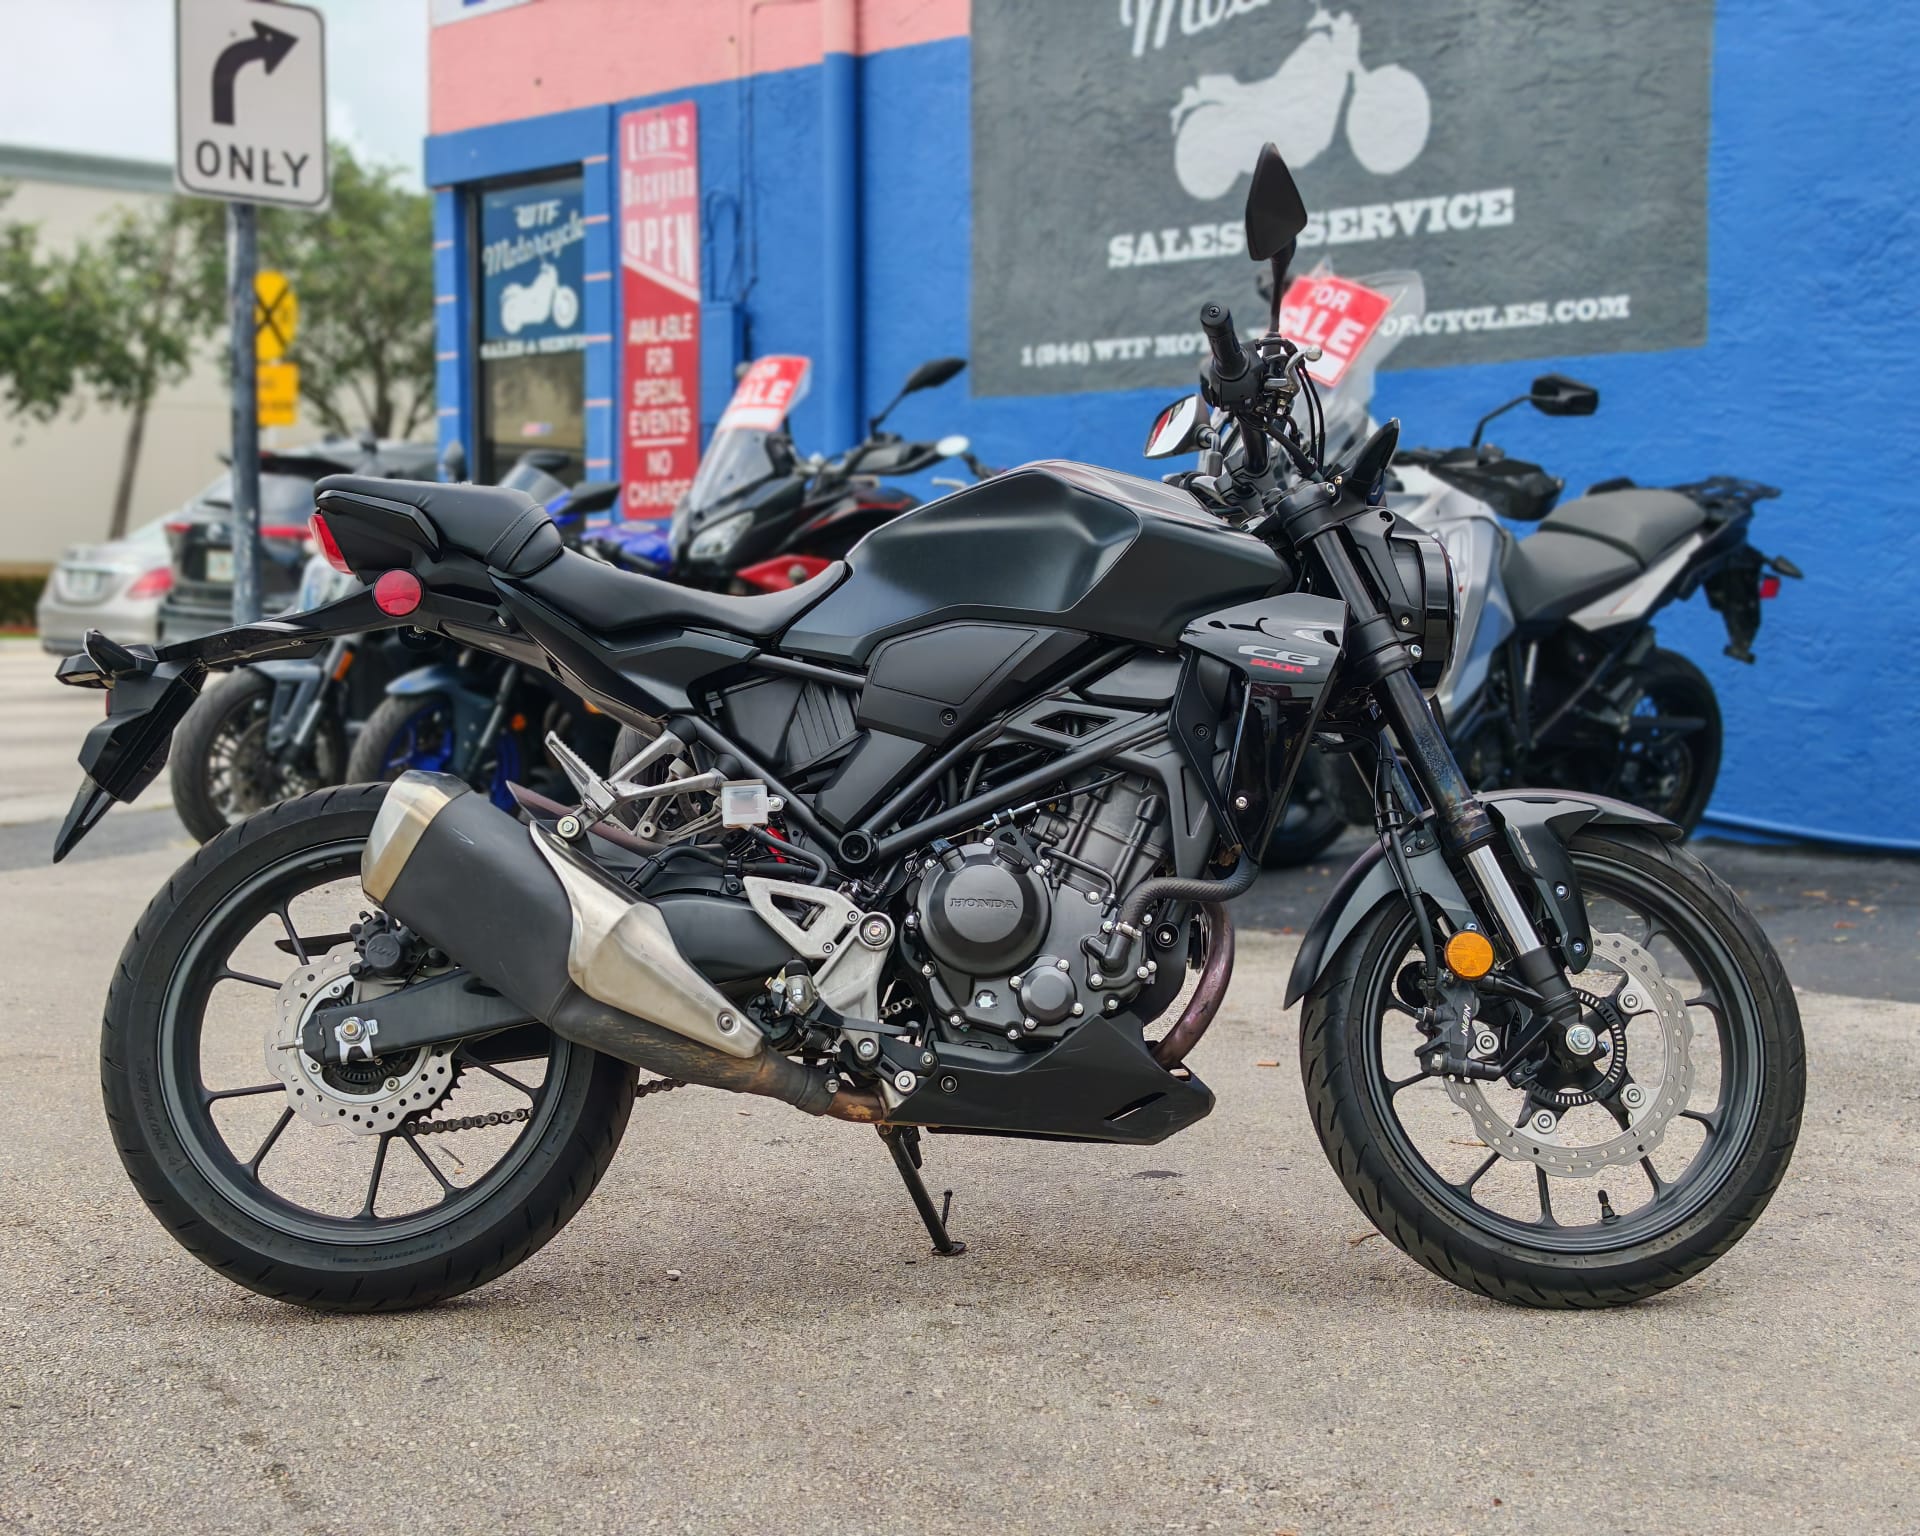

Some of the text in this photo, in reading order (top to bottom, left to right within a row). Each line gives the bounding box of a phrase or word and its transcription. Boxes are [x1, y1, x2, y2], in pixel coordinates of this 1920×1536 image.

[195, 139, 309, 188] ONLY
[482, 210, 587, 276] Motorcycle
[1108, 188, 1514, 268] SALES SERVICE
[625, 213, 696, 283] OPEN
[645, 347, 679, 374] FOR
[1093, 336, 1152, 361] WTF
[1155, 331, 1210, 358] MOT
[633, 378, 686, 406] SPECIAL
[629, 406, 691, 437] EVENTS
[646, 449, 673, 477] NO
[1238, 645, 1320, 665] CB
[949, 898, 1019, 909] HONDA
